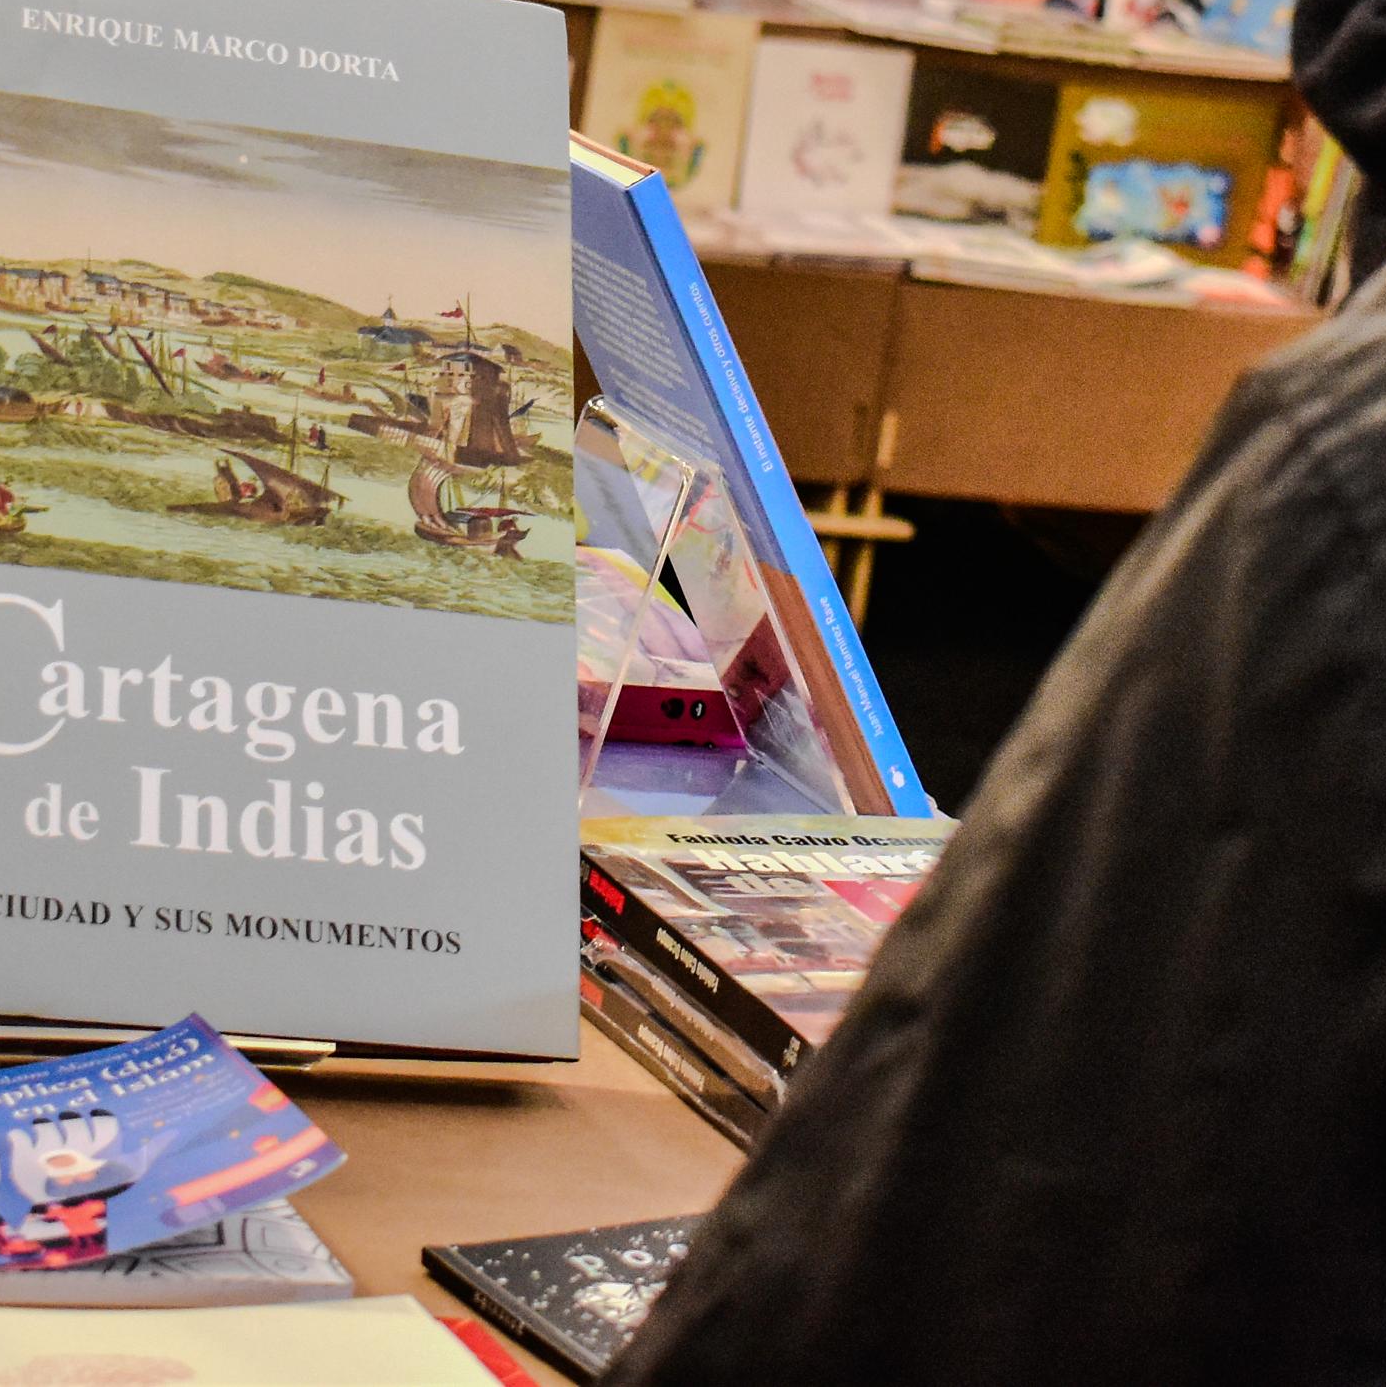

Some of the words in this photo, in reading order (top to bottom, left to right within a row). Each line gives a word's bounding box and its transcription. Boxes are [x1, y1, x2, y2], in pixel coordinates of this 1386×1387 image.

[22, 7, 164, 48] ENRIQUE
[174, 23, 289, 66] MARCO
[297, 44, 401, 83] DORTA
[688, 281, 713, 327] cuentos
[708, 327, 726, 359] otros
[725, 369, 749, 415] decisivo
[744, 416, 768, 461] instante
[762, 457, 773, 473] El
[820, 596, 837, 626] Rave
[831, 623, 855, 670] Ramírez
[848, 669, 873, 712] Manuel
[867, 711, 885, 738] Juan
[25, 782, 100, 842] de
[130, 764, 428, 872] Indias
[666, 832, 768, 847] Fabiola
[772, 833, 850, 848] Calvo
[851, 834, 946, 848] Ocamp
[123, 904, 144, 928] Y
[154, 905, 214, 935] SUS
[225, 911, 463, 956] MONUMENTOS
[100, 1037, 201, 1081] (duá)
[112, 1052, 215, 1098] Islam
